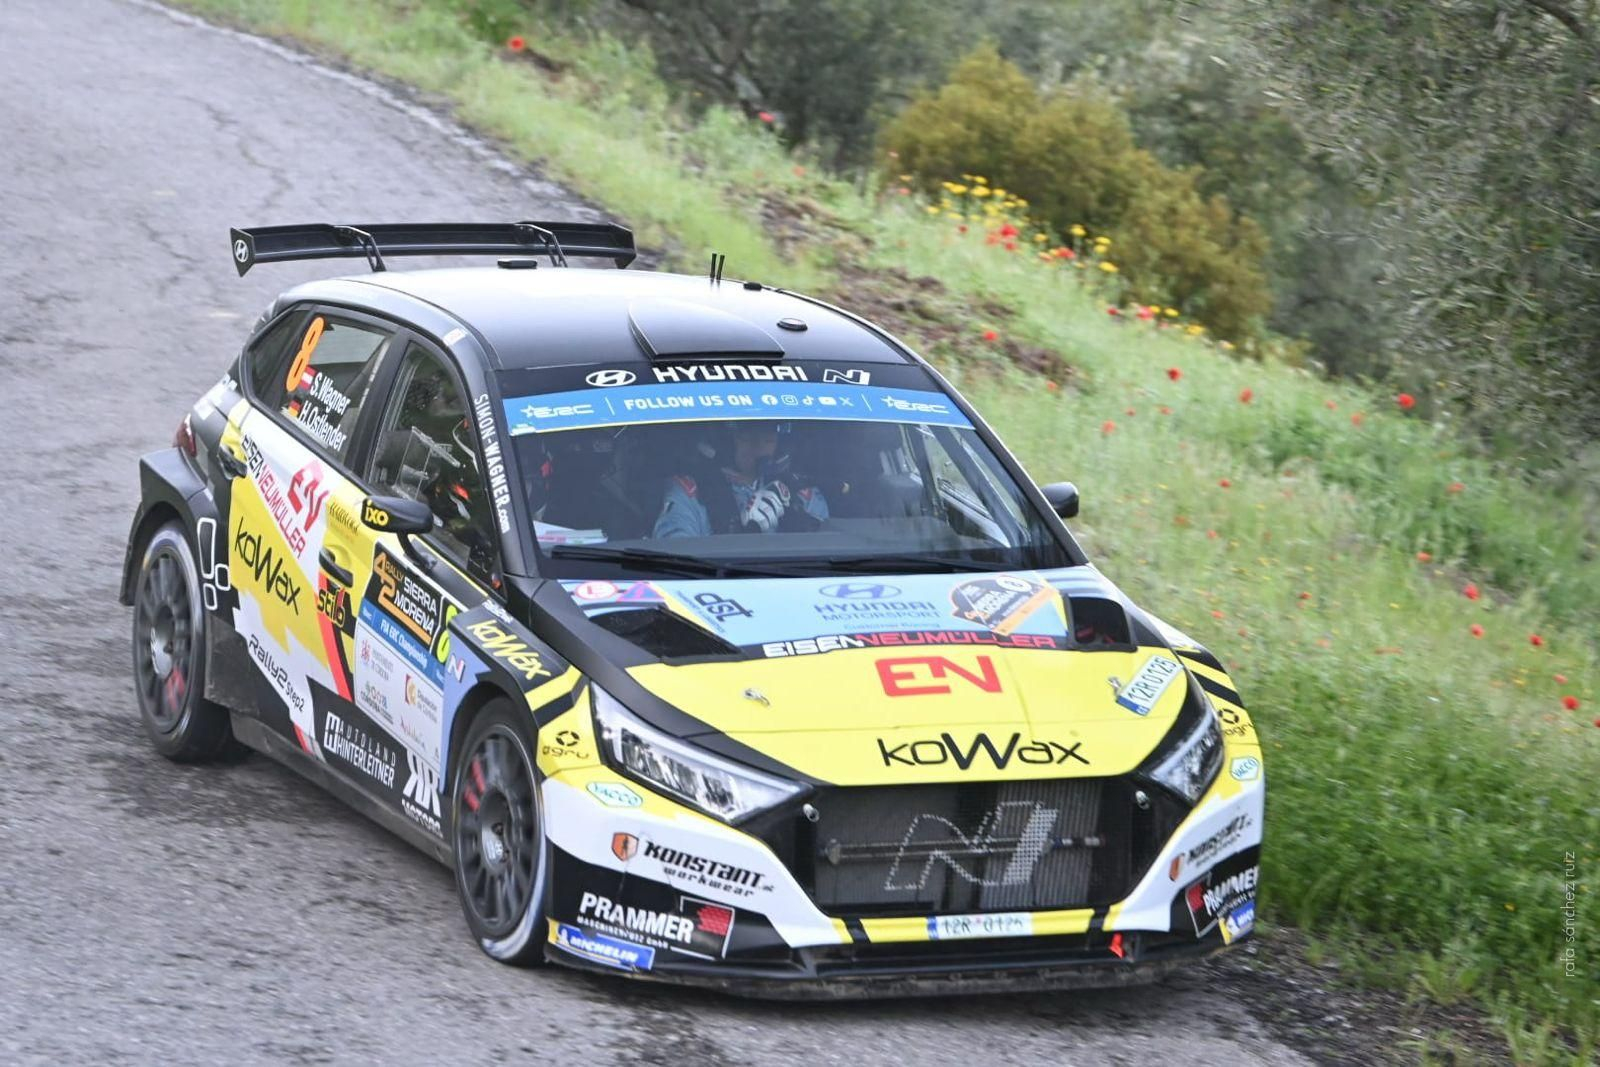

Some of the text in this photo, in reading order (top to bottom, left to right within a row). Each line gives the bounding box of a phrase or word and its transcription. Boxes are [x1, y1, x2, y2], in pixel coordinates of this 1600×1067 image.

[287, 317, 325, 392] 8
[652, 365, 808, 383] HYUNDAI
[310, 372, 351, 416] S.Wagner
[624, 396, 695, 411] FOLLOW
[698, 394, 723, 408] US
[729, 393, 753, 407] ON
[474, 393, 511, 535] SIMON-WAGNER.com
[393, 590, 435, 636] MORENA
[403, 577, 437, 616] SIERRA
[814, 601, 936, 613] HYUNDAI
[822, 611, 941, 622] MOTORSPORT
[249, 634, 288, 688] Rally2
[337, 735, 396, 789] HINTERLEITNER
[663, 867, 754, 898] workwear
[579, 891, 695, 944] PRAMMER
[569, 936, 640, 964] MICHELIN
